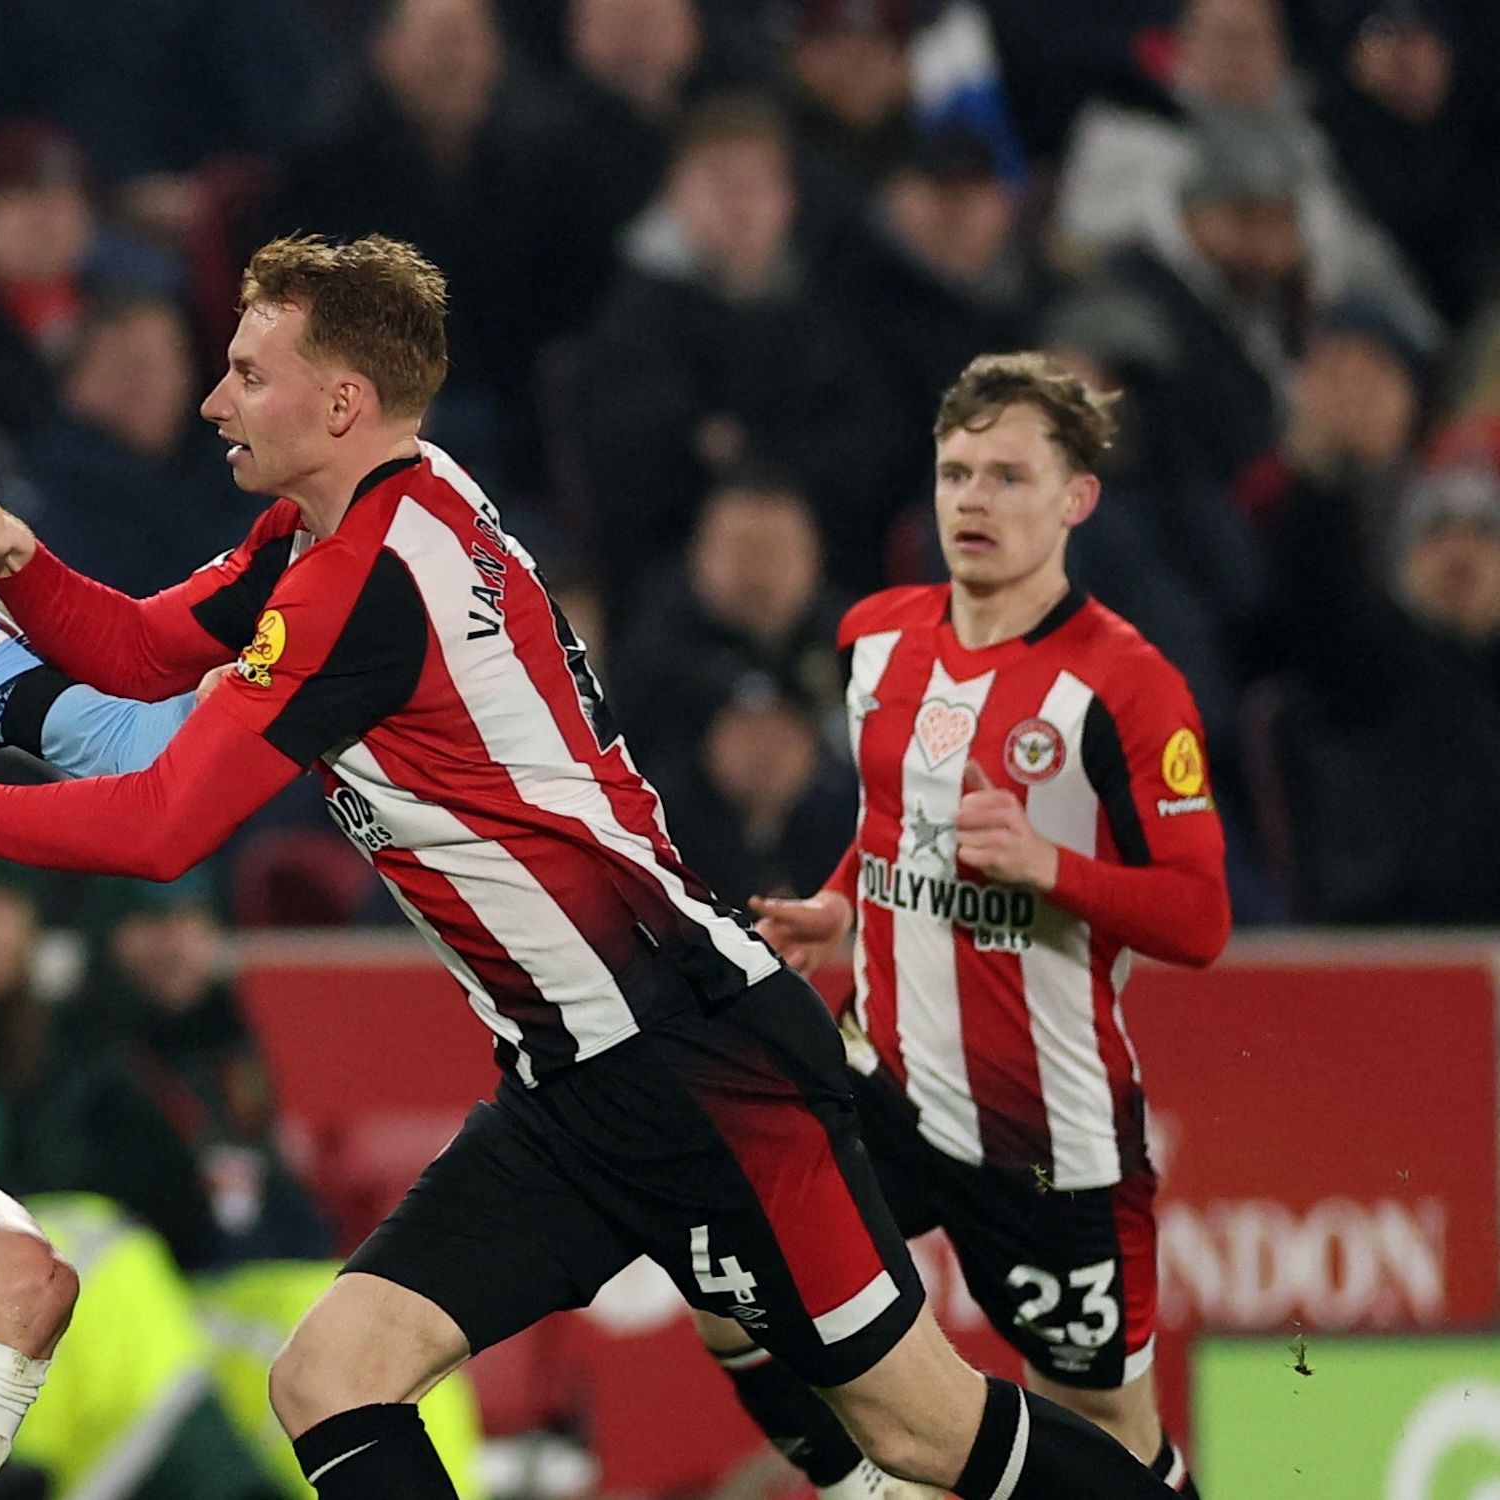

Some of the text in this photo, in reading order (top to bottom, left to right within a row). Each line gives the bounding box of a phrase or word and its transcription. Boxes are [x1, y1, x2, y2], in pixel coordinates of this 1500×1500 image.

[466, 541, 506, 641] VAN
[864, 856, 1036, 927] OLLYWOOD
[977, 924, 1034, 949] bets
[689, 1224, 758, 1304] 4
[1006, 1258, 1120, 1348] 23
[1156, 1198, 1448, 1328] NDON
